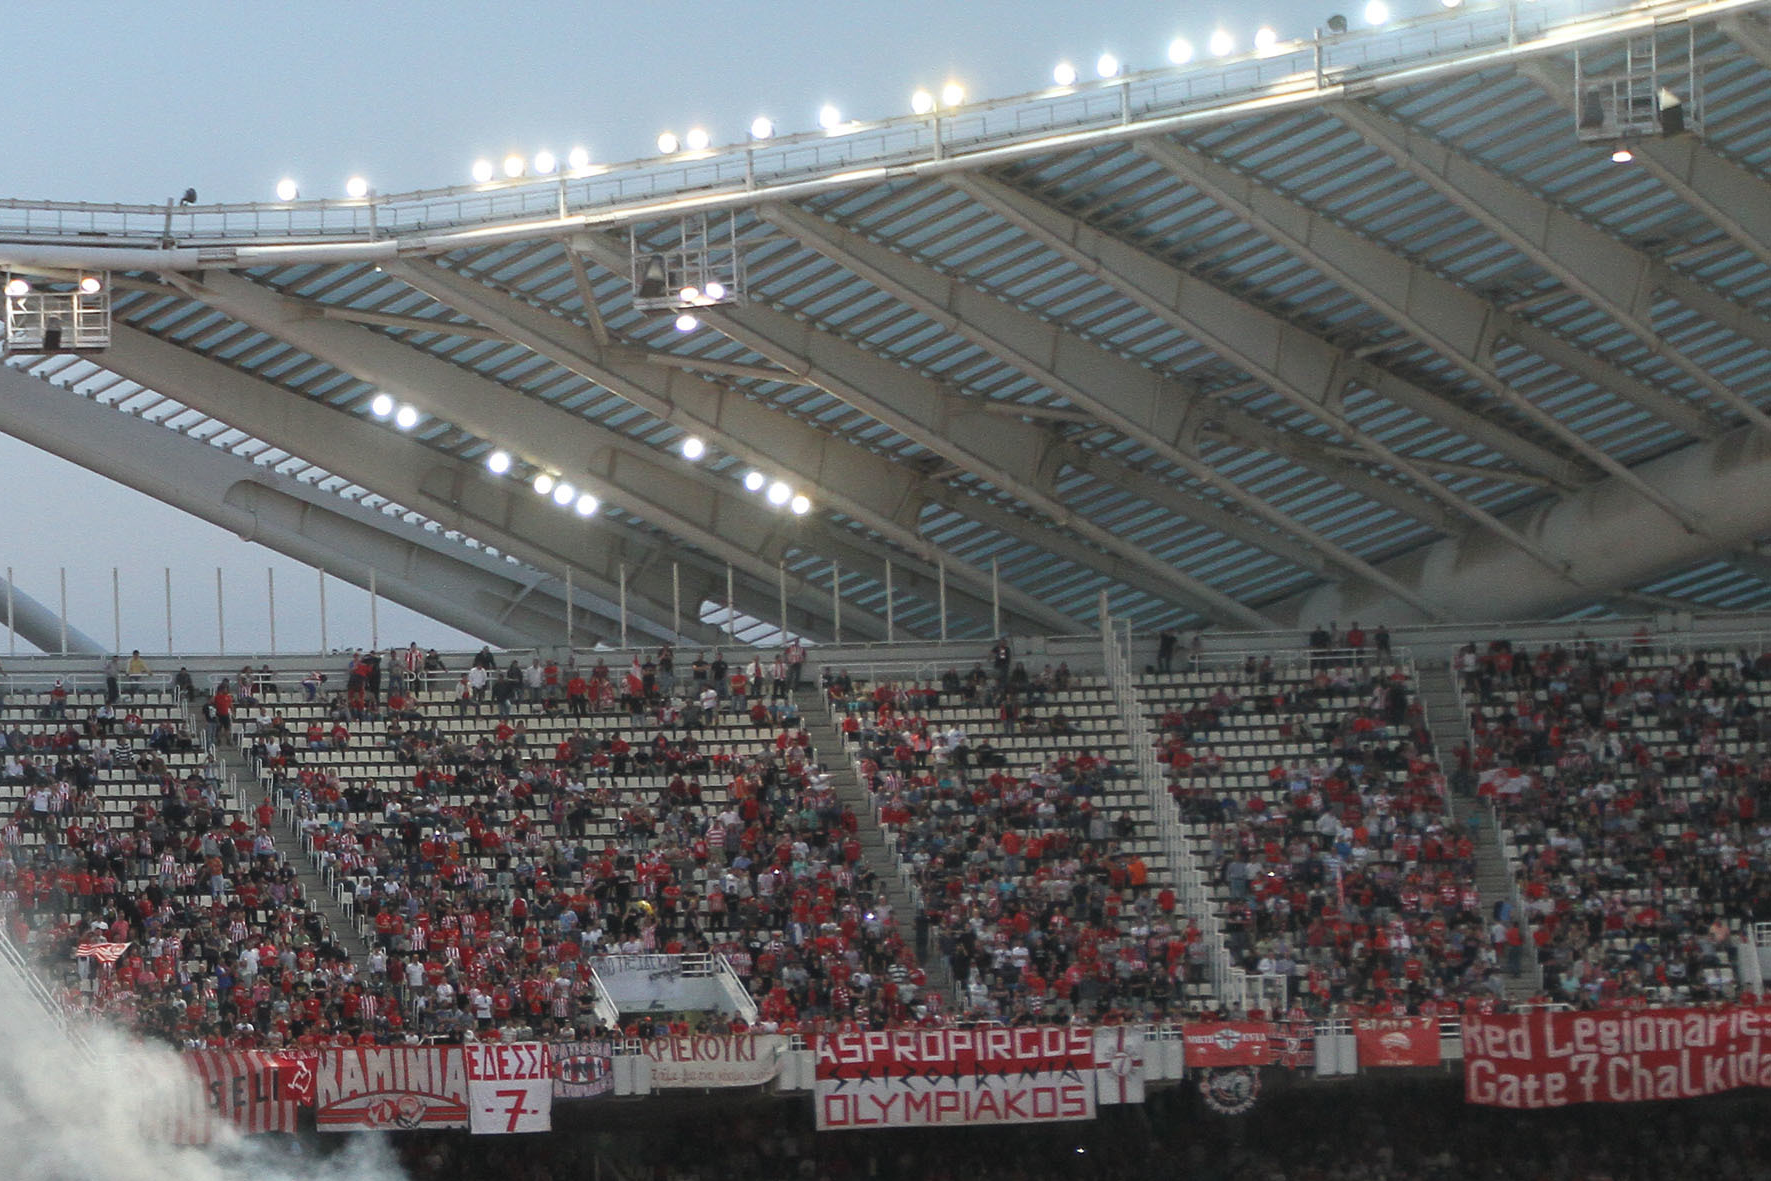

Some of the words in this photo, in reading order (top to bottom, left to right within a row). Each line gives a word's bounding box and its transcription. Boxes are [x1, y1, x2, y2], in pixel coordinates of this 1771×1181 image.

[817, 1026, 1092, 1065] ASPROPIRGOS
[1463, 1012, 1531, 1059] Red
[316, 1048, 467, 1108] KAMINIA
[466, 1043, 553, 1081] ΕΔΕΣΣΑ
[1469, 1060, 1568, 1108] Gate
[1571, 1053, 1599, 1101] 7
[824, 1085, 1086, 1127] OLYMPIAKOS
